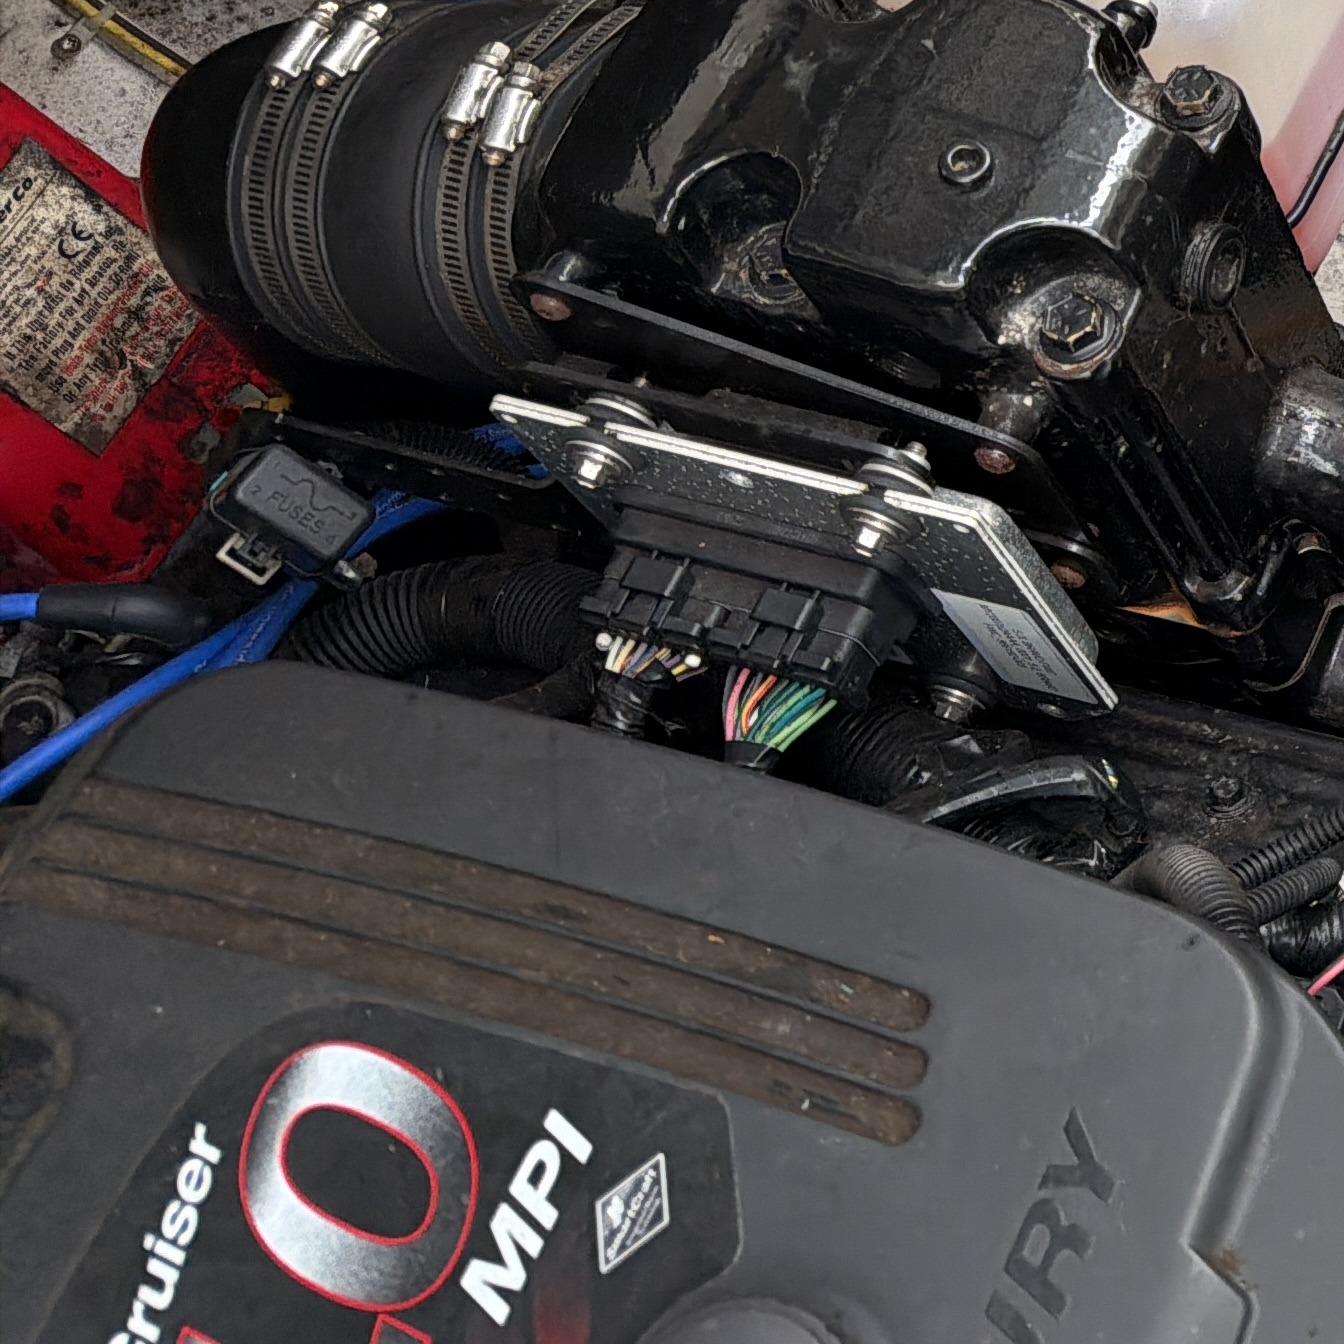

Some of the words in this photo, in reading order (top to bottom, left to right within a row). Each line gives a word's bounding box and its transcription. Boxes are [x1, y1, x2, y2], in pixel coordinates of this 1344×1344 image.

[10, 170, 40, 203] Co.
[25, 308, 49, 333] Unit
[41, 288, 66, 314] Must
[32, 319, 66, 356] Factory
[50, 336, 76, 363] Plug
[265, 488, 326, 535] FUSES
[458, 1106, 594, 1328] MPI
